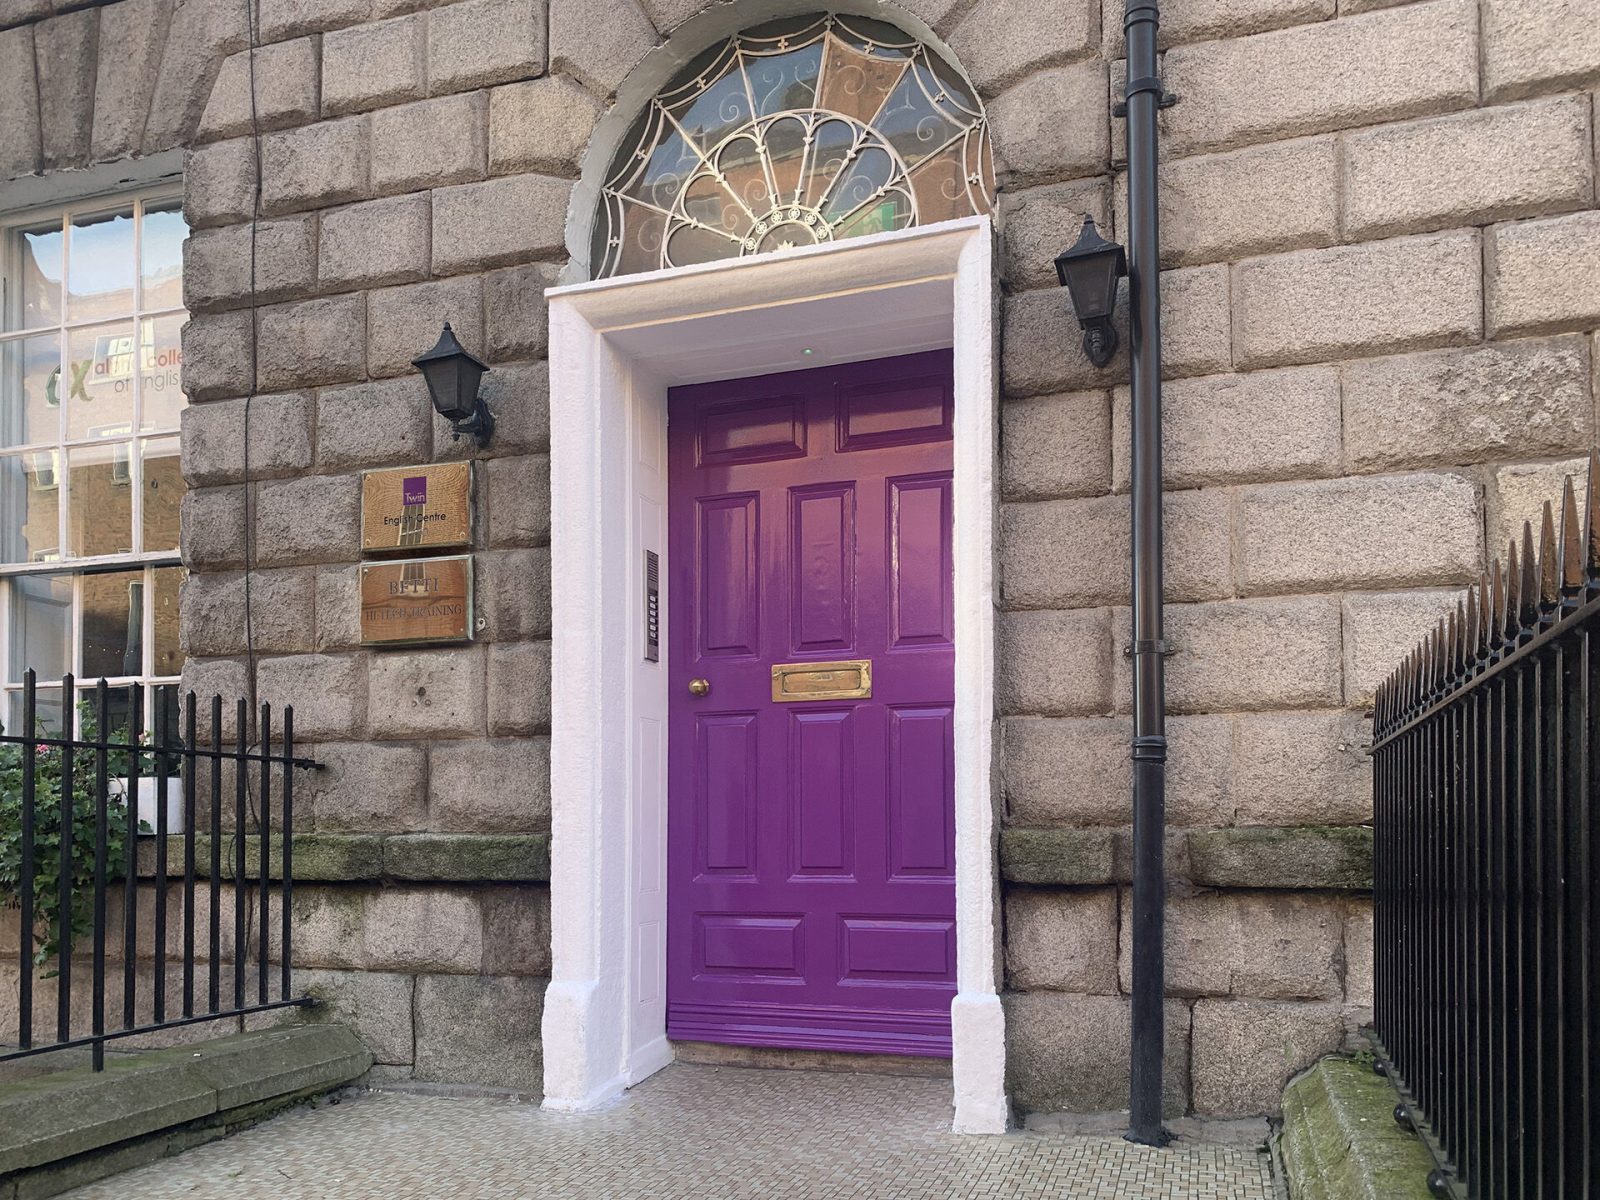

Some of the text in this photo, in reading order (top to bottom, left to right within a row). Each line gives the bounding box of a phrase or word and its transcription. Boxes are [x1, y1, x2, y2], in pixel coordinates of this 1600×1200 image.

[114, 371, 179, 393] of nglis
[404, 492, 425, 503] Twin
[383, 512, 447, 527] English Centre
[389, 578, 440, 595] BETTI
